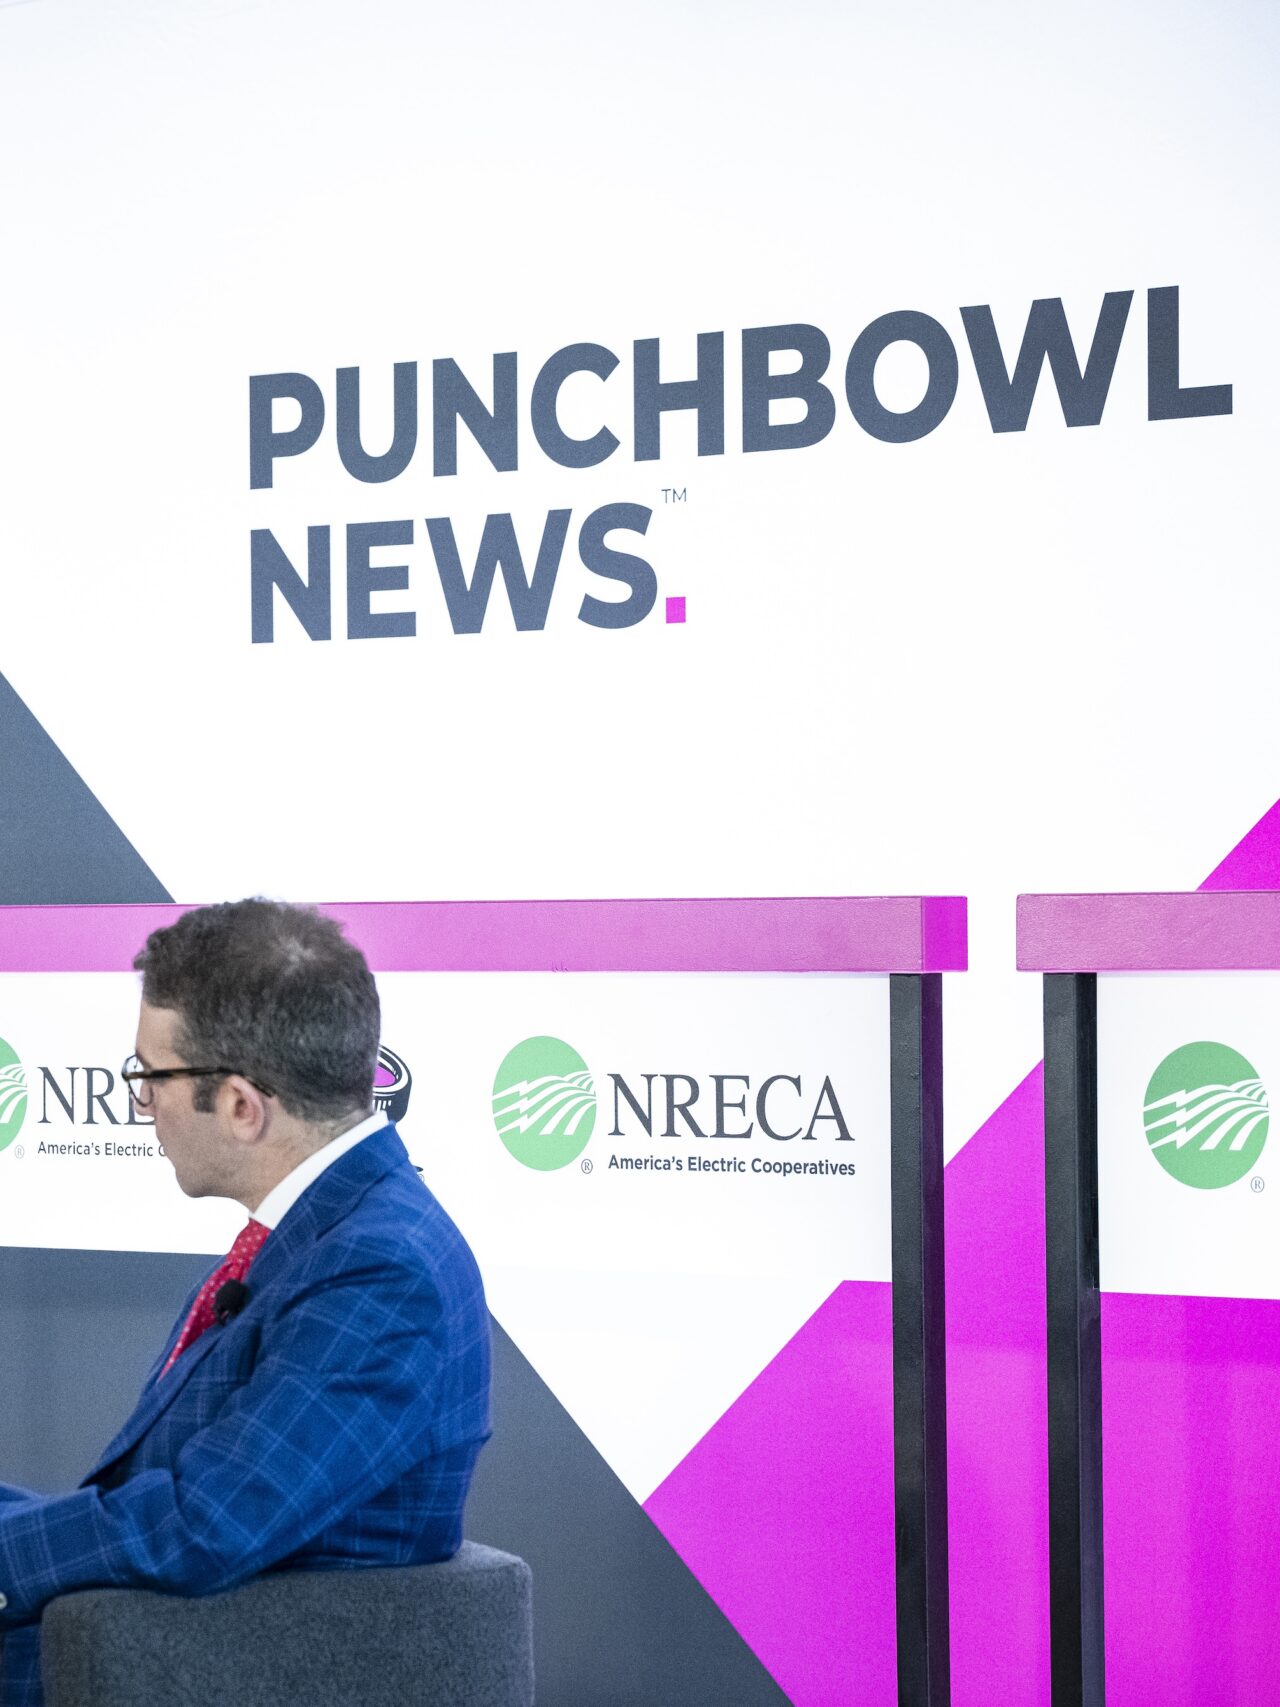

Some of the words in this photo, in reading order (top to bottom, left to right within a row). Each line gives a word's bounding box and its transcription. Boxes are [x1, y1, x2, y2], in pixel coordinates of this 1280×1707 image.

[248, 284, 1234, 491] PUNCHBOWL
[249, 501, 687, 645] NEWS.
[607, 1073, 856, 1141] NRECA
[37, 1140, 101, 1156] America's
[105, 1142, 154, 1157] Electric
[608, 1154, 683, 1171] America's
[687, 1155, 746, 1173] Electric
[751, 1157, 856, 1177] Cooperatives
